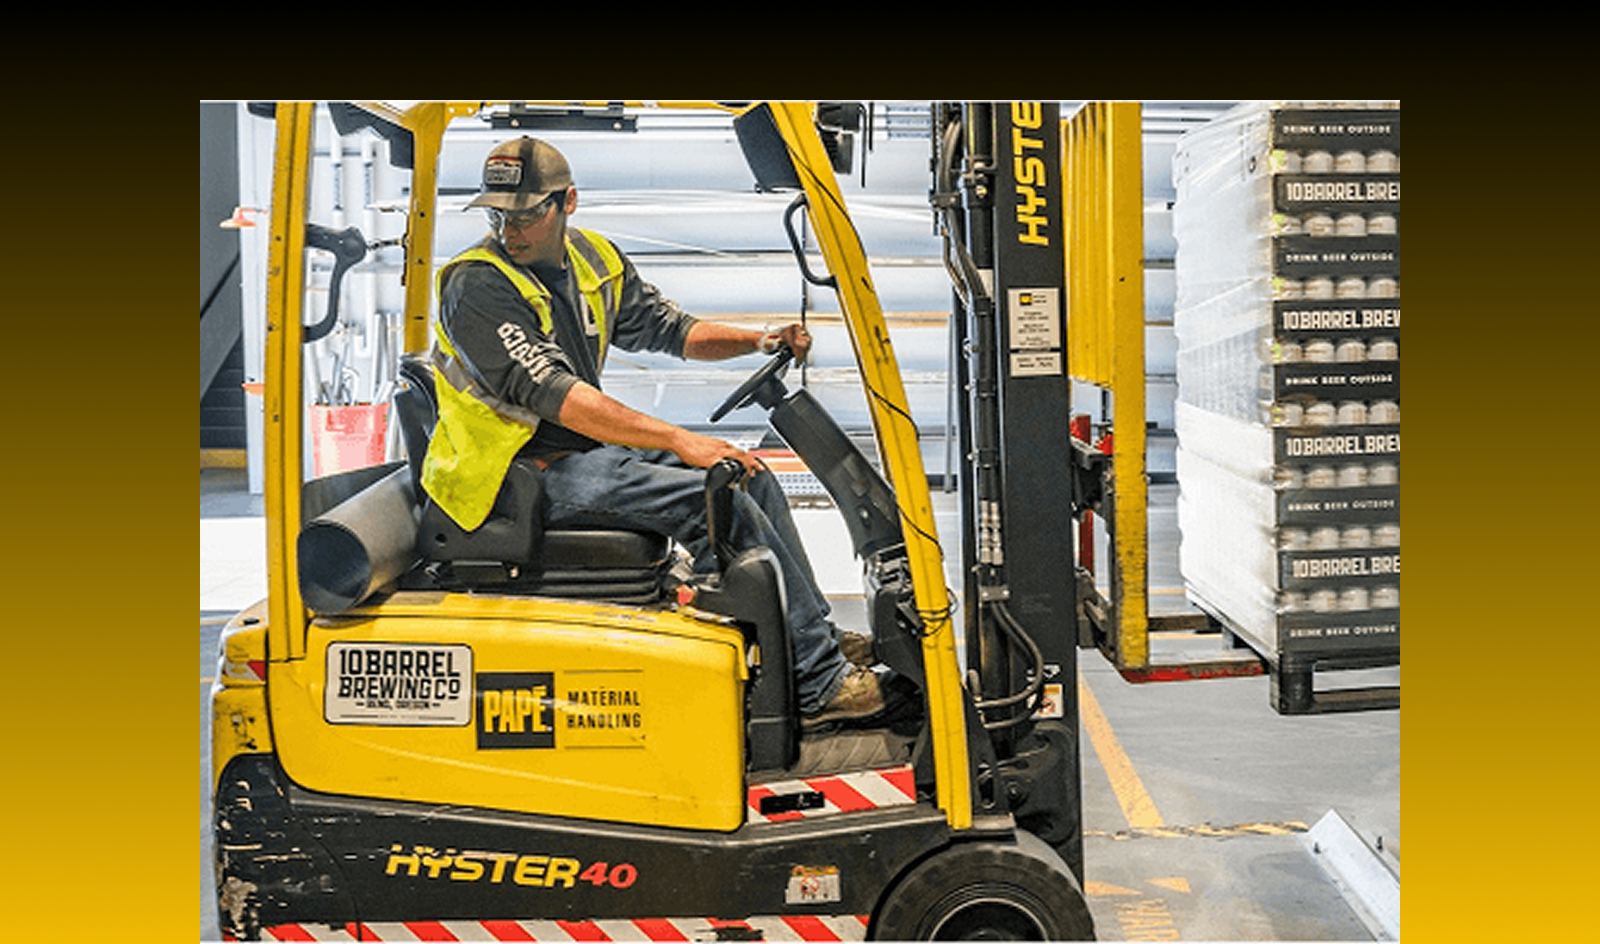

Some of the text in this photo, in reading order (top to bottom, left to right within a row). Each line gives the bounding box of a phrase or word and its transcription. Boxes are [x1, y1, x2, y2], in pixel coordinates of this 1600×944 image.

[1282, 125, 1391, 134] DRINK BEER OUTSIDE
[1285, 252, 1394, 262] DRINK BEER OUTSIDE
[1285, 374, 1393, 385] DRINK BEER OUTSIDE
[568, 691, 640, 706] MATERIAL
[567, 713, 642, 728] HANDLING
[385, 844, 580, 888] HYSTER
